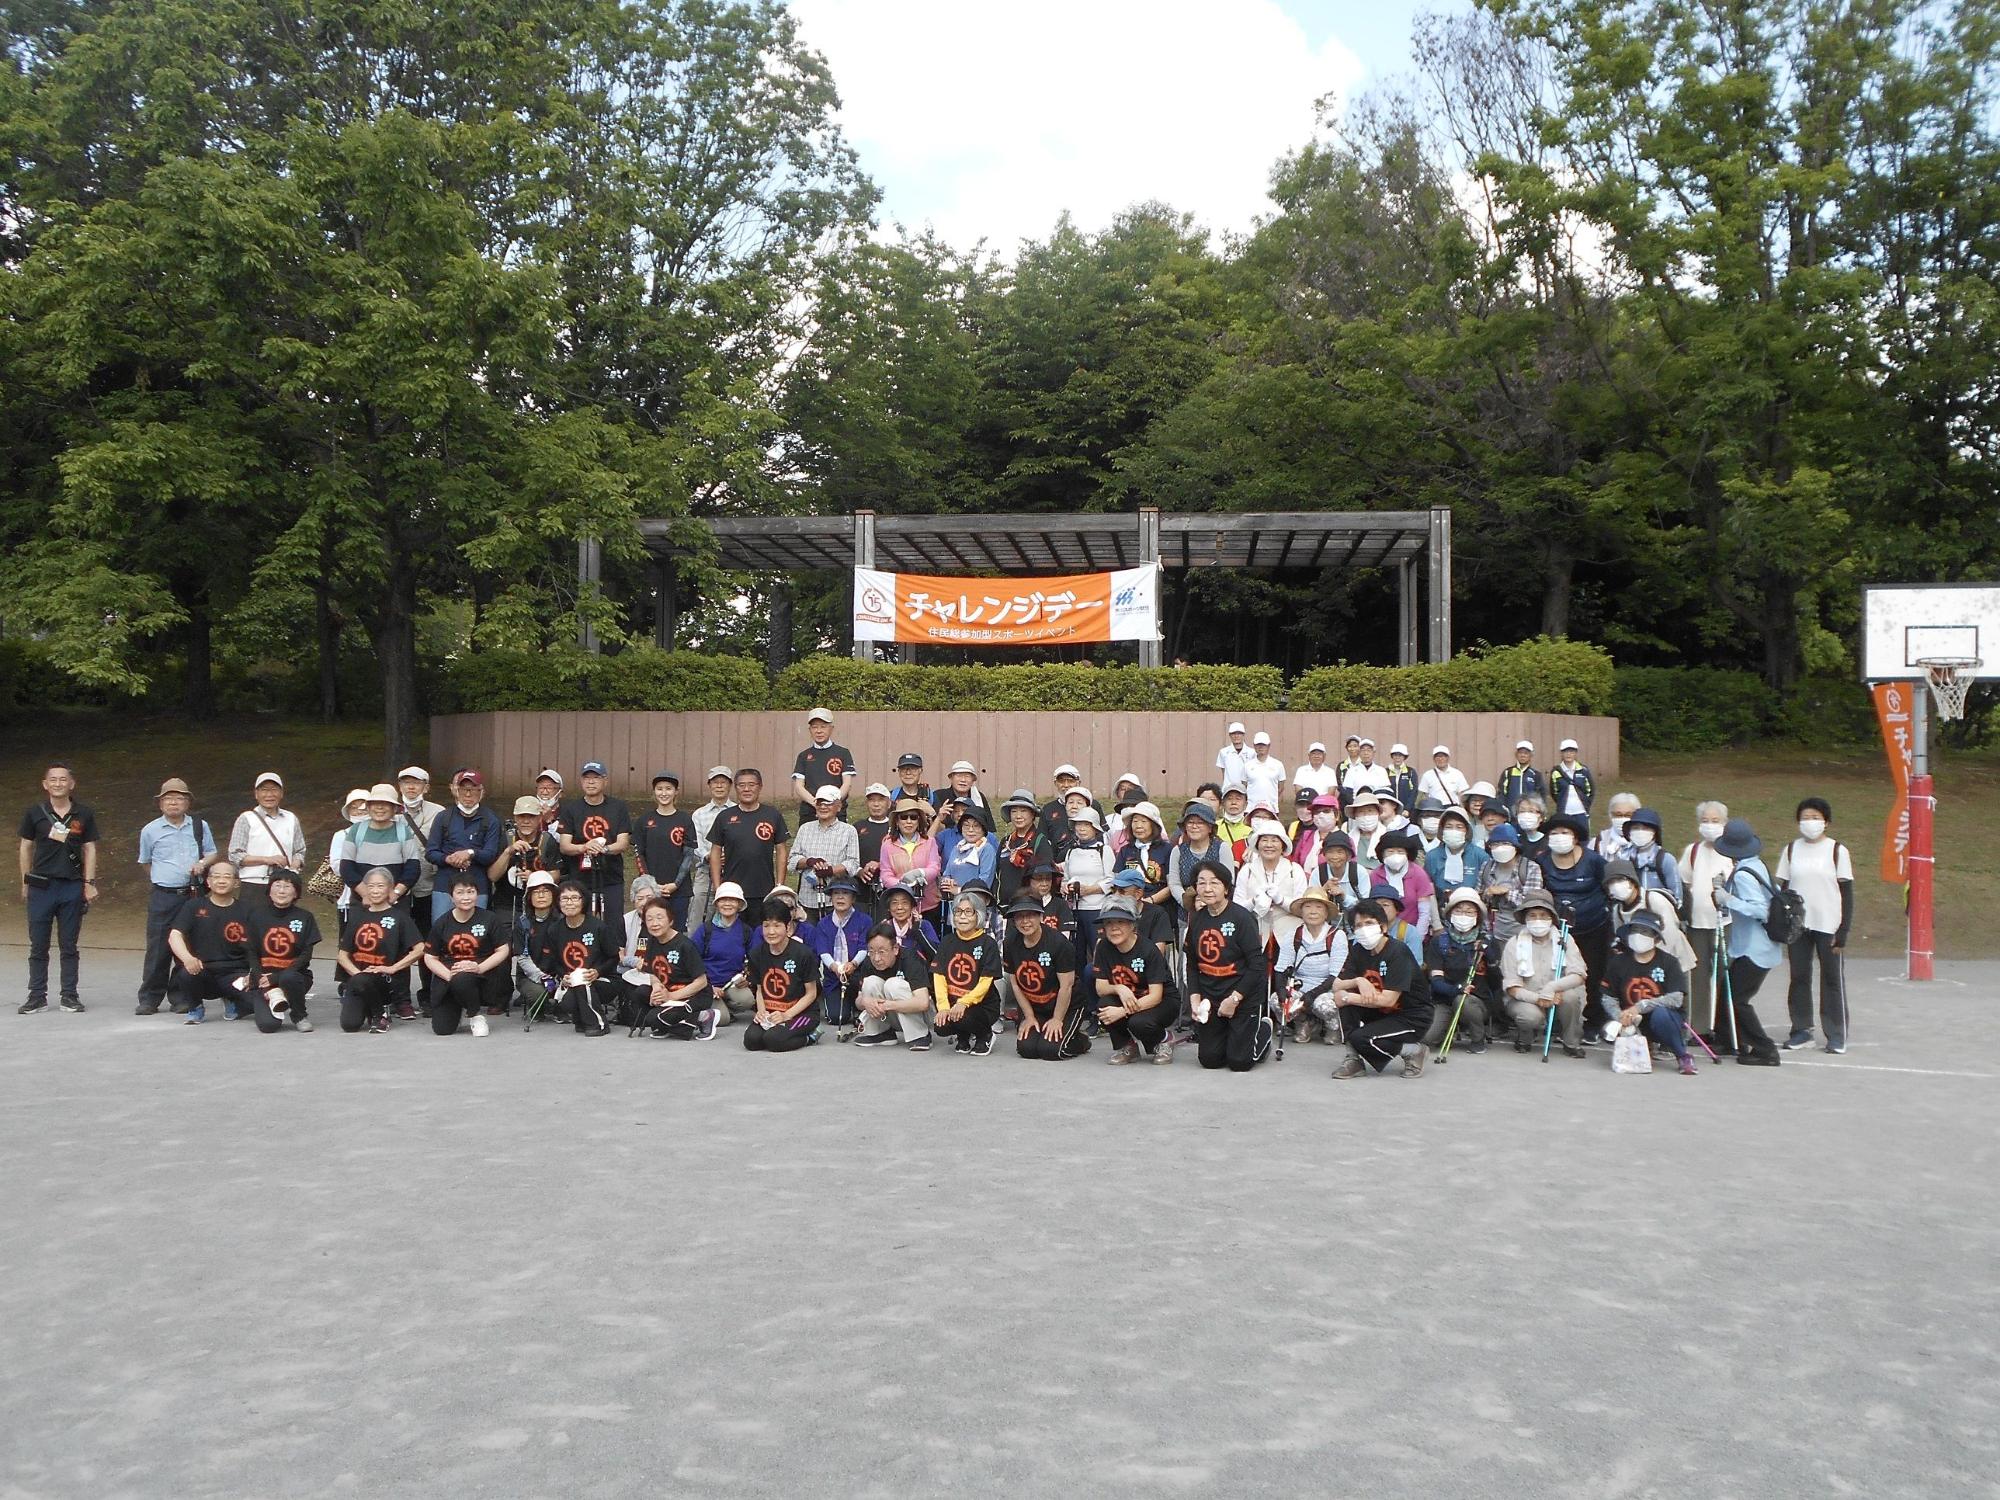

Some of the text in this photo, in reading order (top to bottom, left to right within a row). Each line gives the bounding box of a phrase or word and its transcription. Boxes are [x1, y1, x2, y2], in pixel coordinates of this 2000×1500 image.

[904, 590, 1104, 625] チャレンジデー
